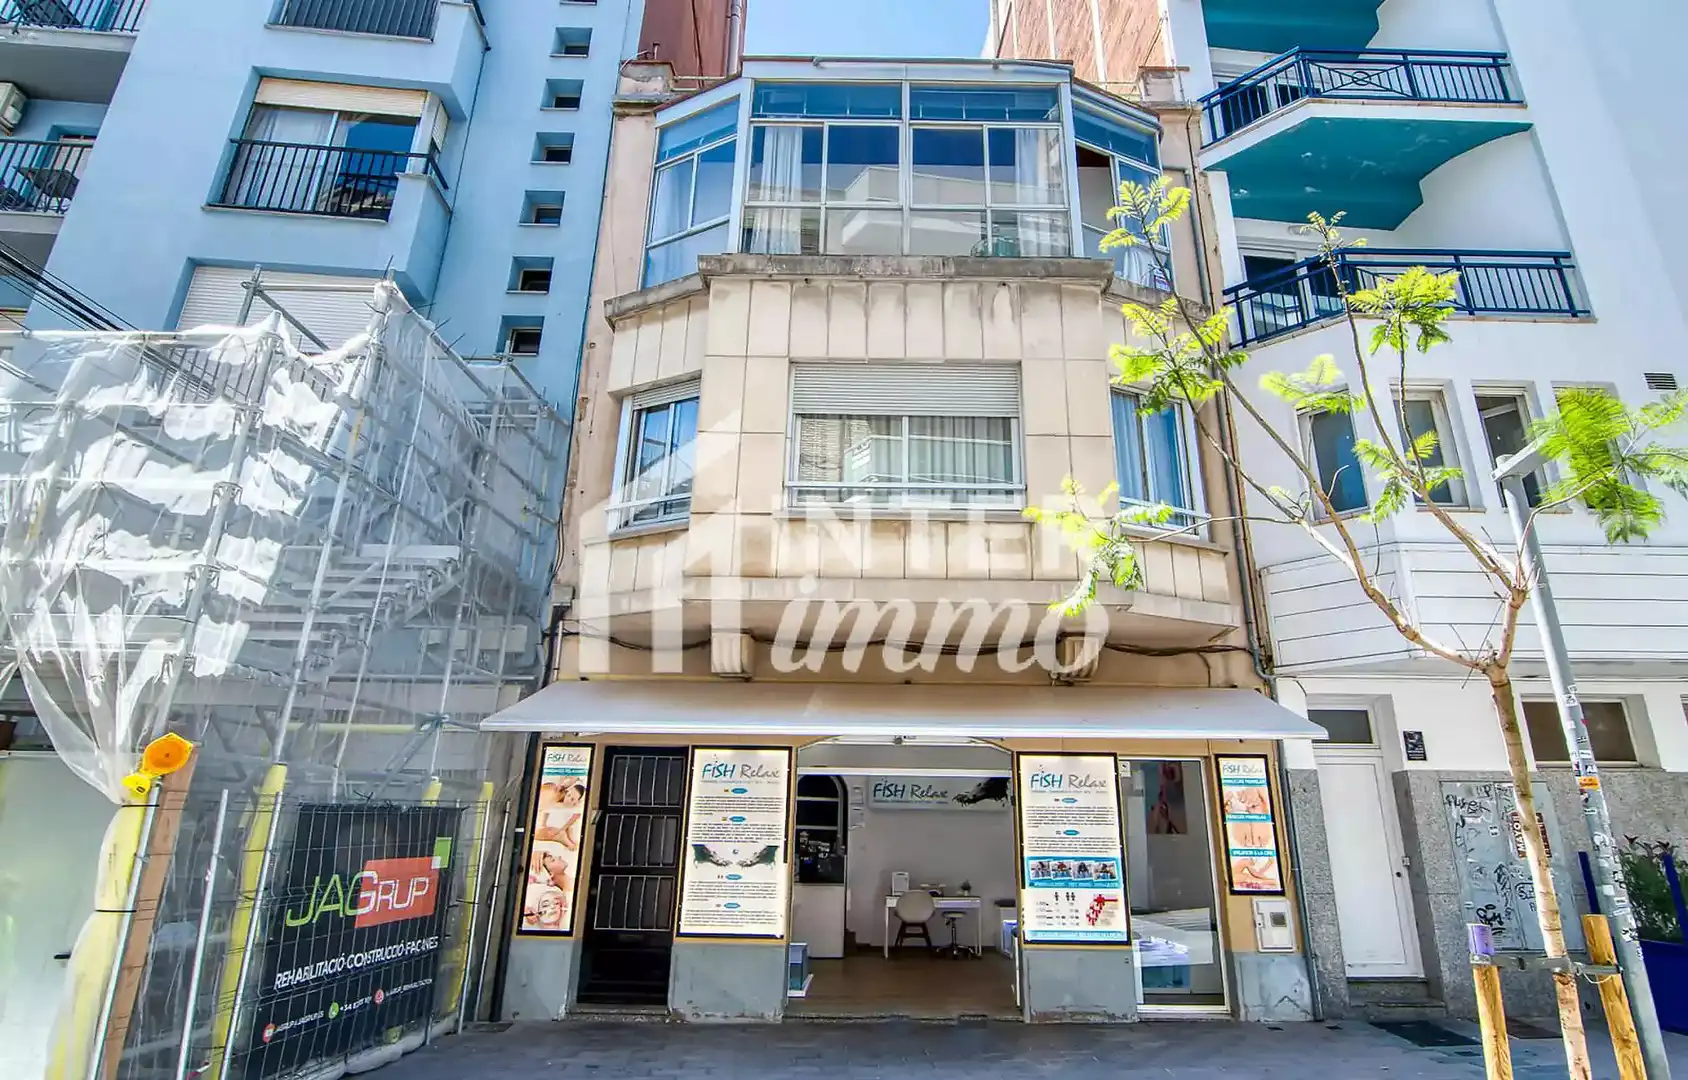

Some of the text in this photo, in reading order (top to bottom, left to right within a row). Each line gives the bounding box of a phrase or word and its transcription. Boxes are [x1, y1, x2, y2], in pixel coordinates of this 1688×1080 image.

[740, 763, 780, 779] Relax
[1068, 773, 1106, 788] Relax
[910, 784, 948, 801] Relax
